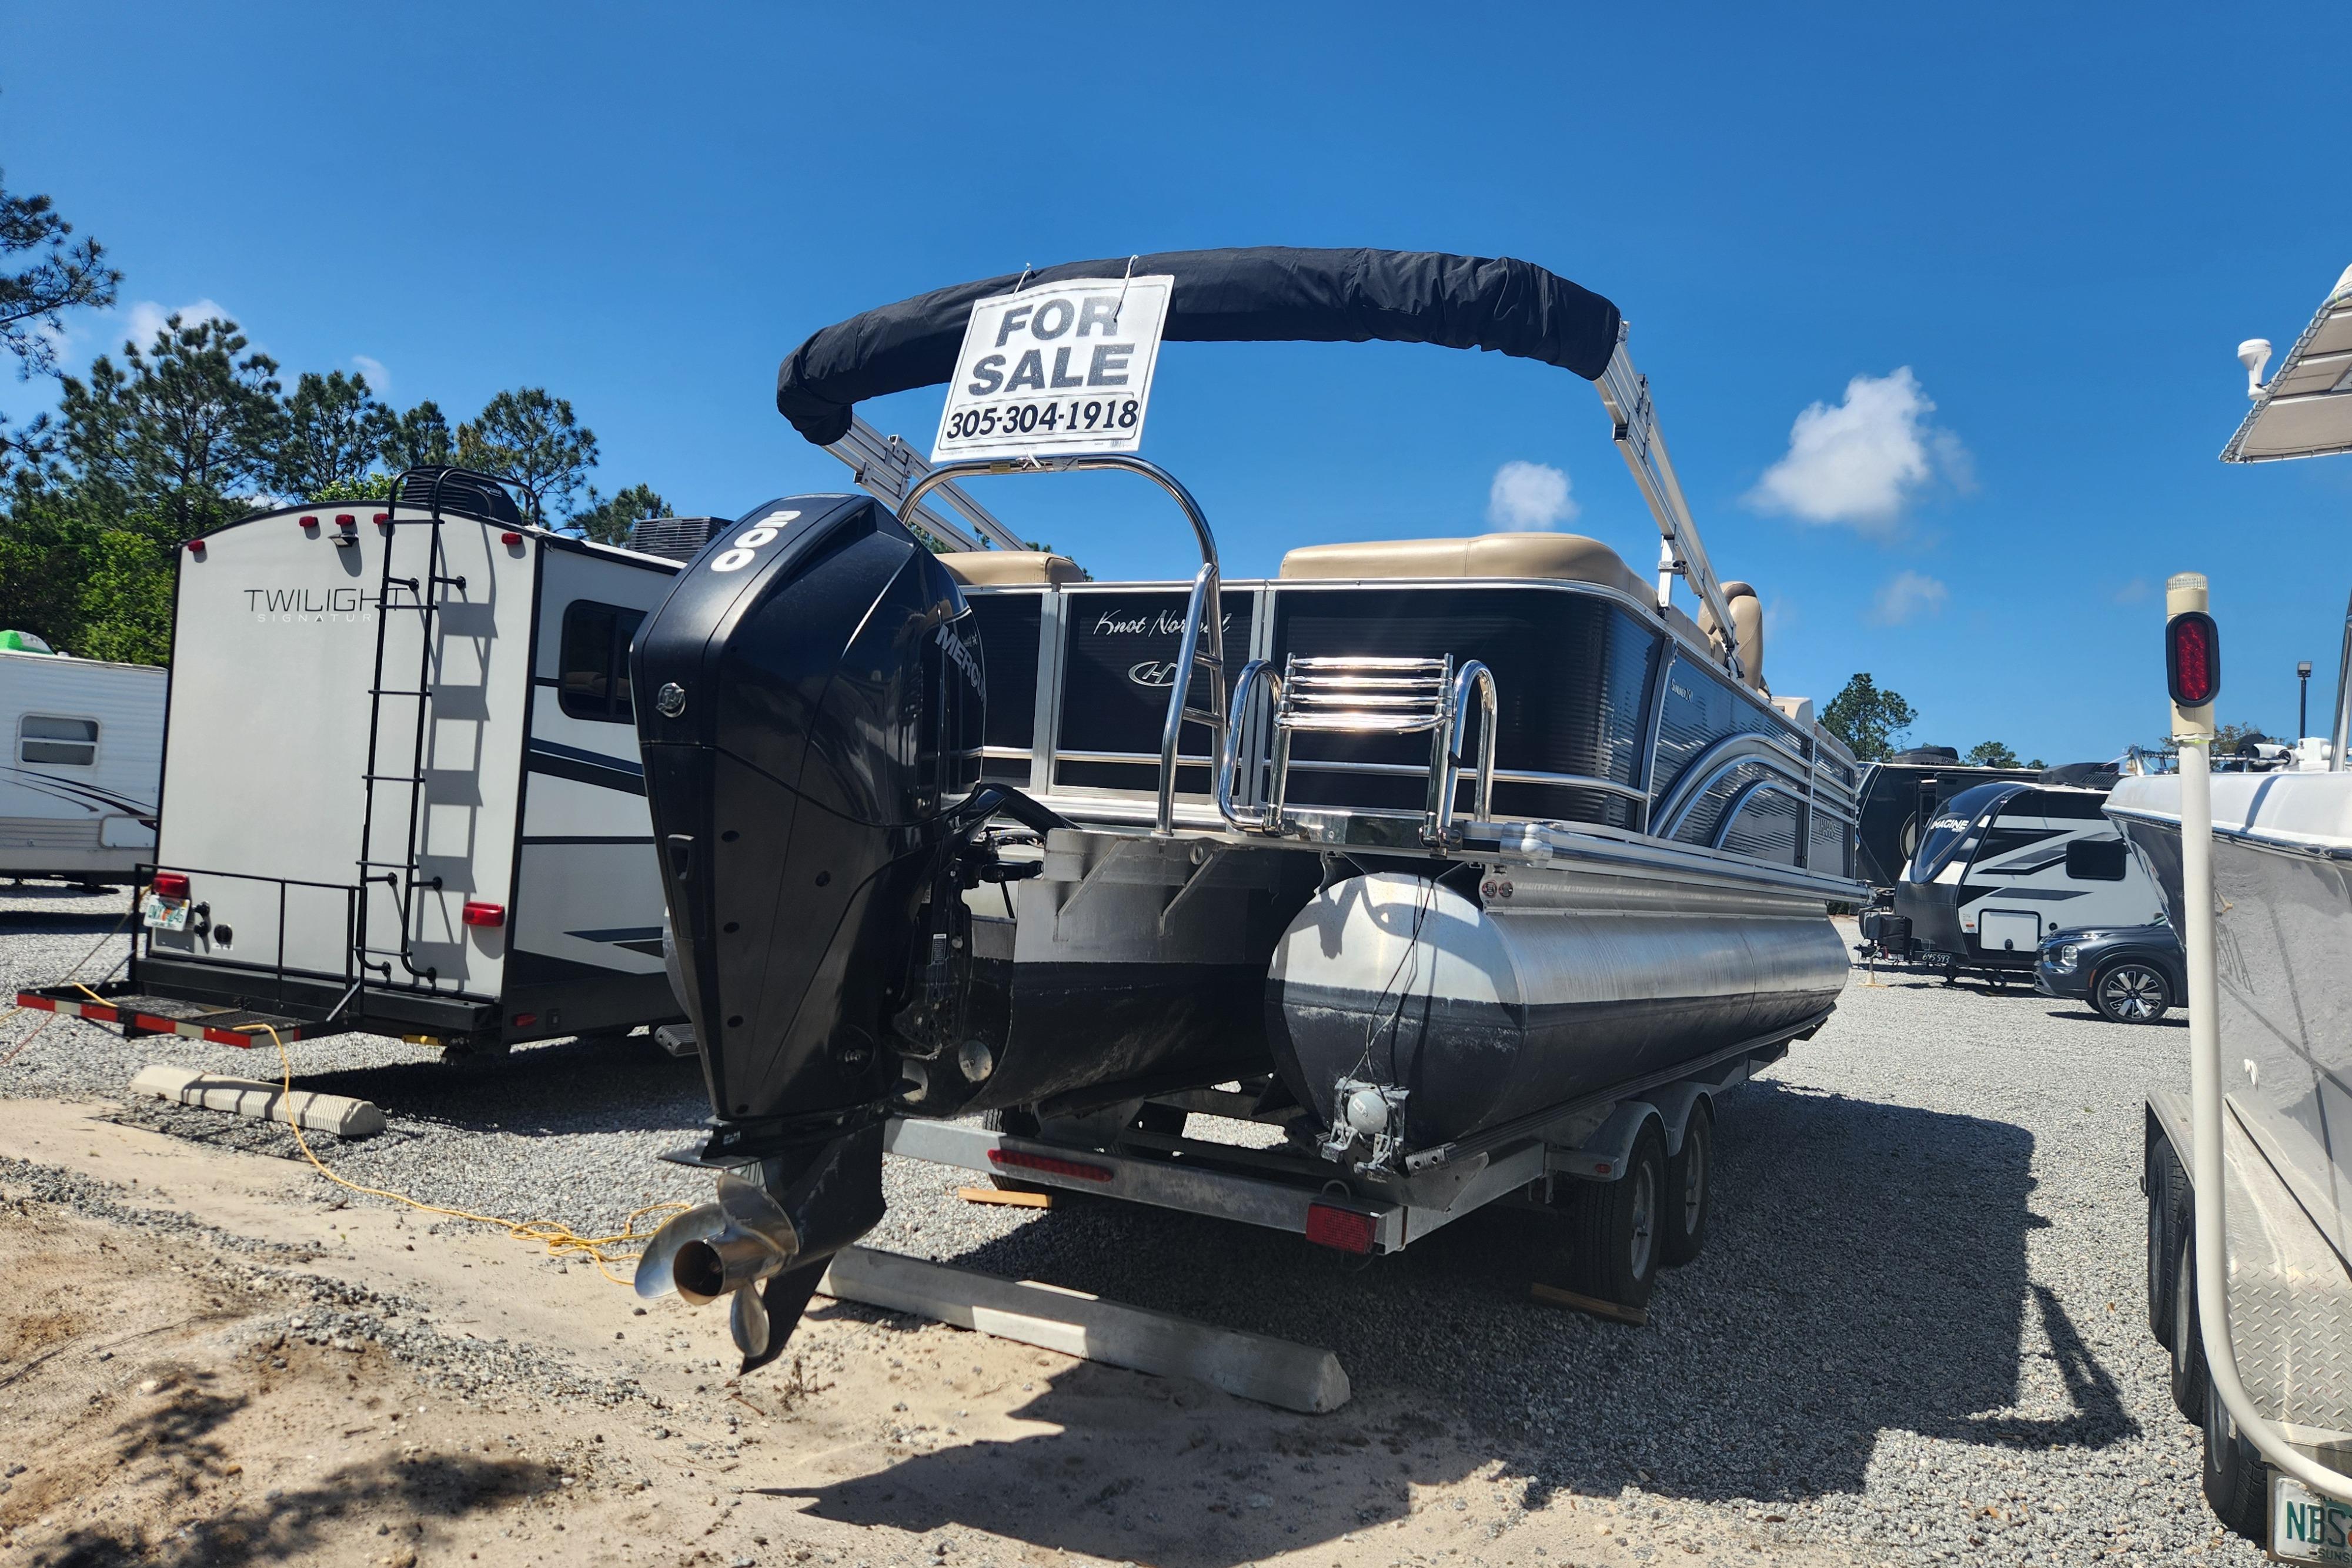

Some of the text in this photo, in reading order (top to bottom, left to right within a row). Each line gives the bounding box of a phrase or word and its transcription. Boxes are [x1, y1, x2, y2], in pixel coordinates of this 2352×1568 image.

[995, 296, 1123, 347] FOR
[968, 342, 1135, 396] SALE
[946, 400, 1139, 439] 305-304-1918
[710, 510, 801, 572] 200
[244, 587, 408, 611] TWILIGHT
[258, 614, 372, 622] SIGNATUR
[1093, 609, 1232, 637] Knot Norl
[934, 623, 985, 702] MERCU
[2318, 1547, 2352, 1564] SUNS
